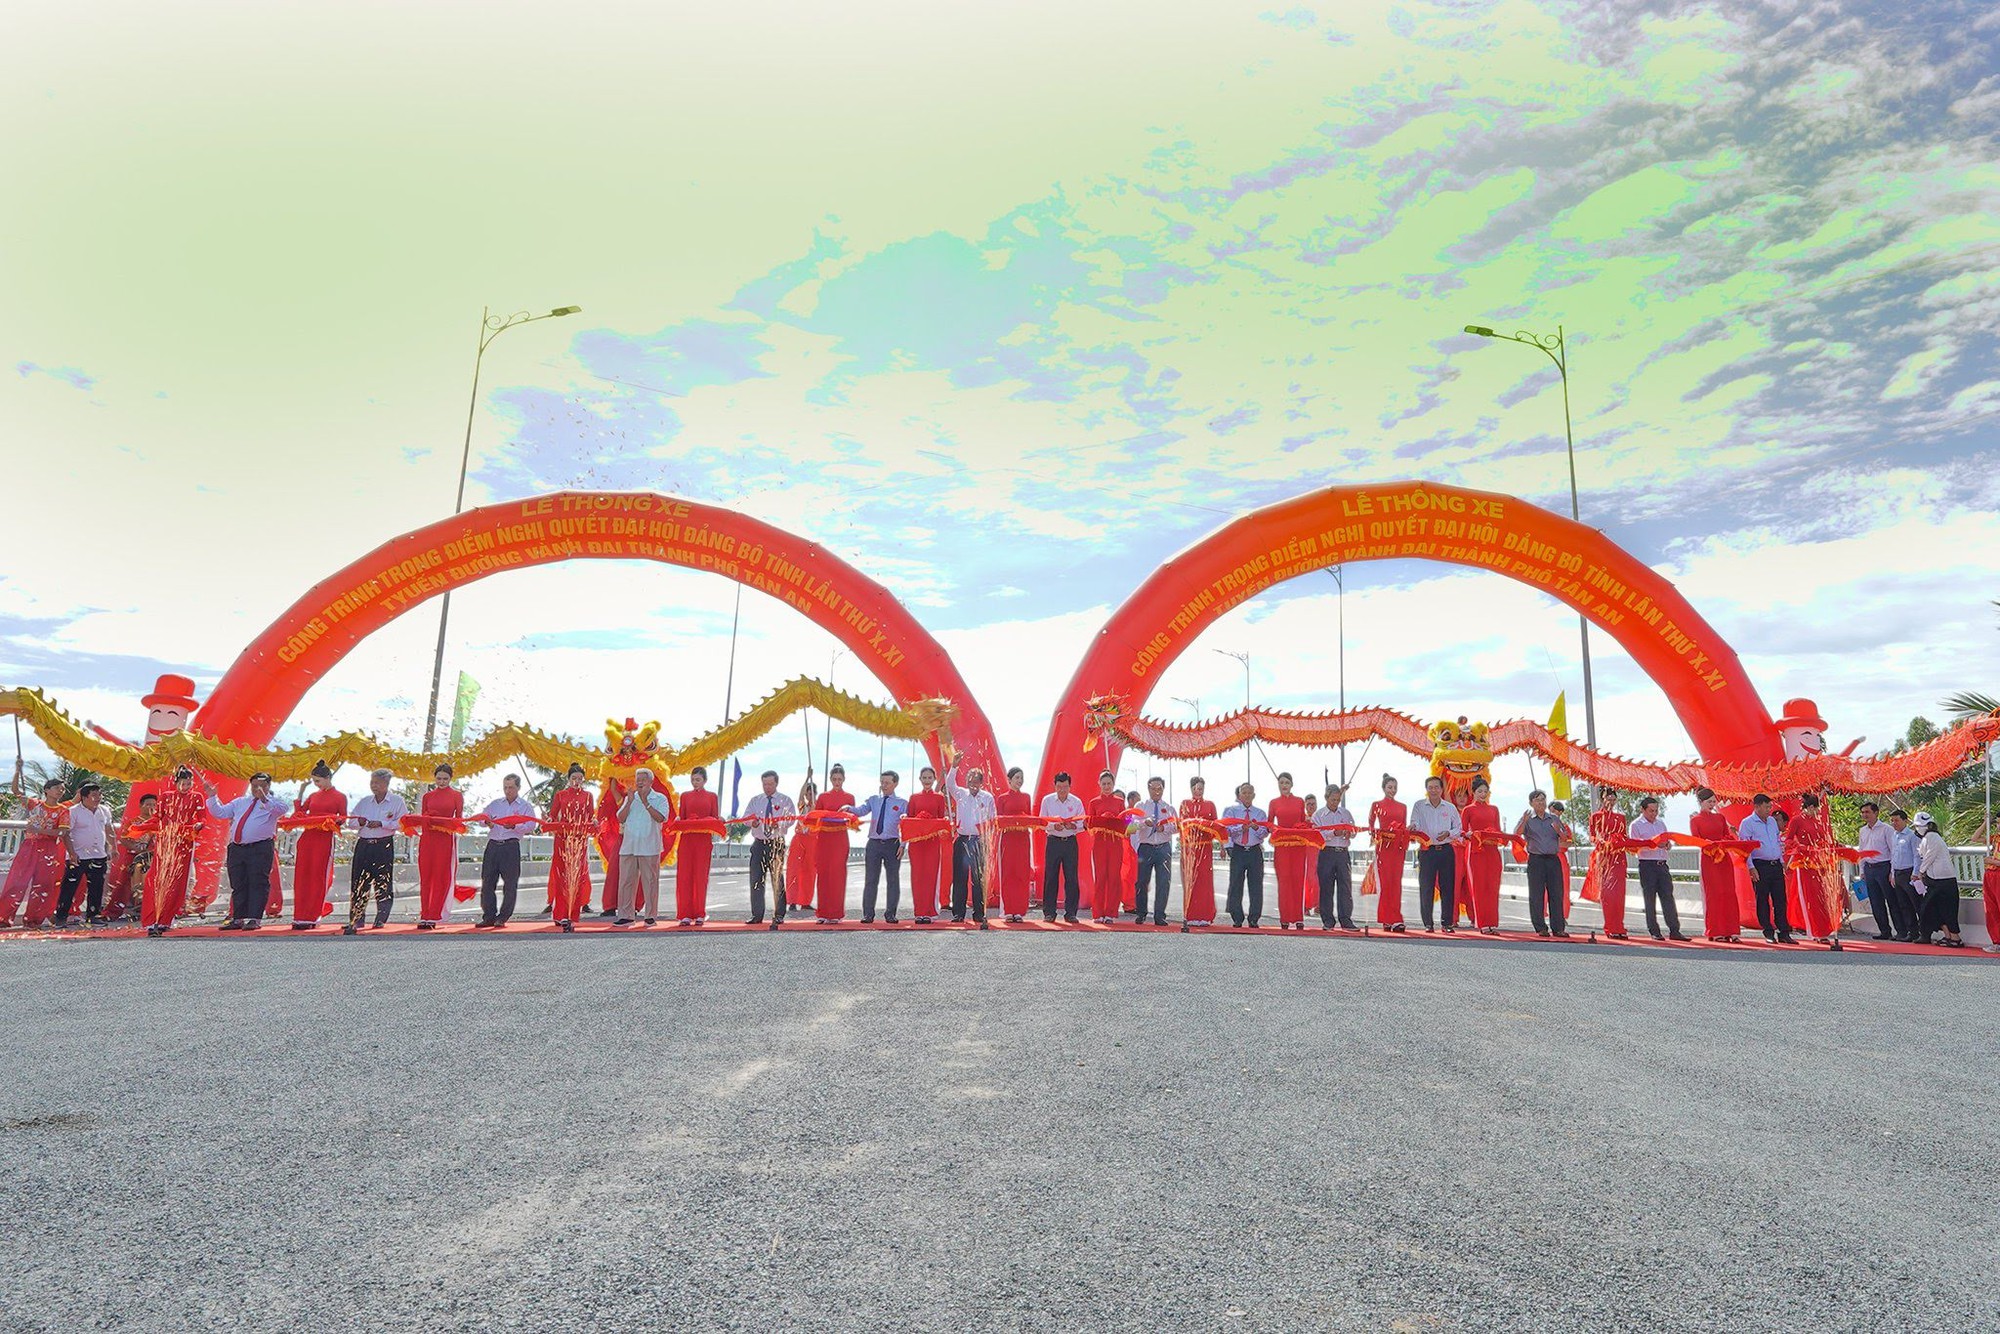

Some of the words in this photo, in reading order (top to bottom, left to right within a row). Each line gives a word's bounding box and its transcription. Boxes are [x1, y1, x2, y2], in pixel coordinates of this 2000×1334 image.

[656, 498, 692, 518] XE
[1342, 491, 1374, 517] LỄ
[1376, 488, 1466, 513] THÔNG
[1472, 499, 1504, 519] XE
[277, 617, 329, 663] CÔNG
[322, 579, 382, 624] TRÌNH
[377, 548, 443, 588] TRỌNG
[549, 511, 608, 536] QUYẾT
[649, 518, 680, 543] HỘI
[684, 523, 736, 555] ĐẢNG
[736, 541, 764, 567] BỘ
[765, 552, 807, 586] TỈNH
[587, 540, 622, 554] ĐAI
[744, 568, 782, 594] TÂN
[785, 589, 813, 614] AN
[1131, 632, 1172, 678] CÔNG
[1168, 588, 1215, 635] TRÌNH
[1212, 554, 1270, 597] TRỌNG
[1270, 536, 1318, 566] ĐIỂM
[1370, 513, 1428, 539] QUYẾT
[1434, 518, 1466, 539] ĐẠI
[1468, 521, 1499, 546] HỘI
[1503, 532, 1557, 563] ĐẢNG
[1583, 564, 1627, 601] TỈNH
[1344, 544, 1396, 560] VÀNH
[1401, 542, 1437, 555] ĐAI
[1441, 544, 1511, 569] THÀNH
[1554, 576, 1595, 606] TÂN
[1591, 602, 1625, 626] AN
